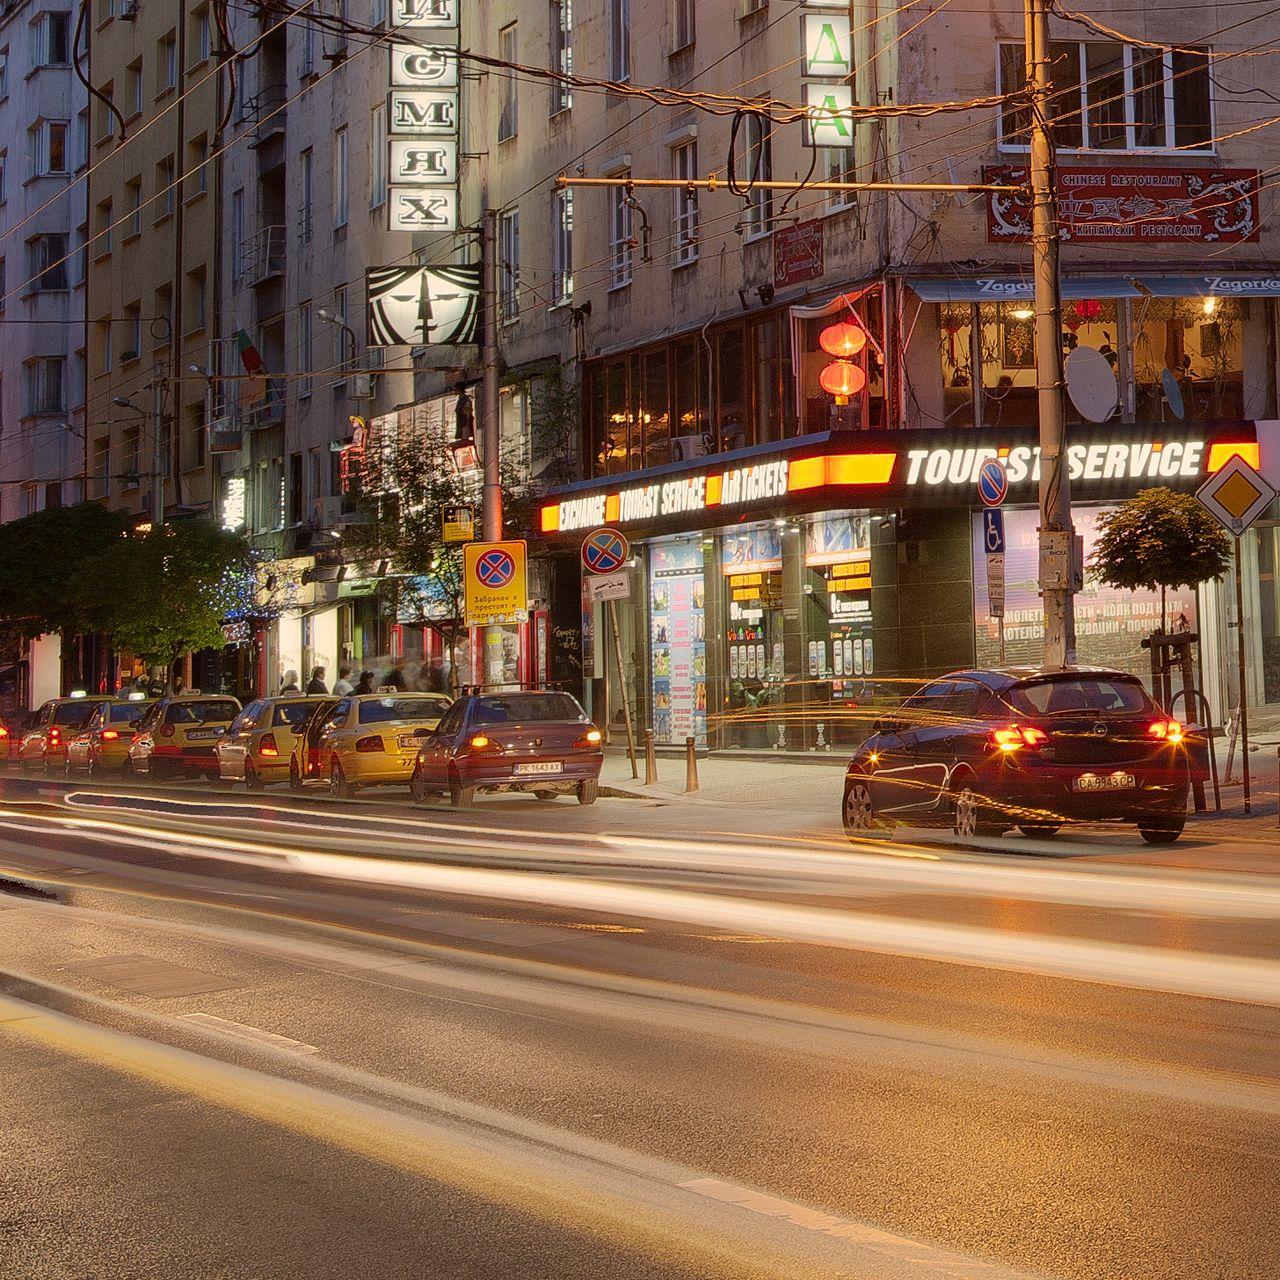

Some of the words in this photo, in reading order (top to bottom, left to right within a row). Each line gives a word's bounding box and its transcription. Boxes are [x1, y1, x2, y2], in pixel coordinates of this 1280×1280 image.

[396, 49, 454, 224] СМЯХ
[1062, 174, 1105, 187] CHINESE
[1112, 174, 1182, 187] RESTOURANT
[1140, 224, 1202, 236] РЕСТОРАНТ
[977, 279, 1034, 294] Zagor
[559, 495, 606, 531] EXCHANGE
